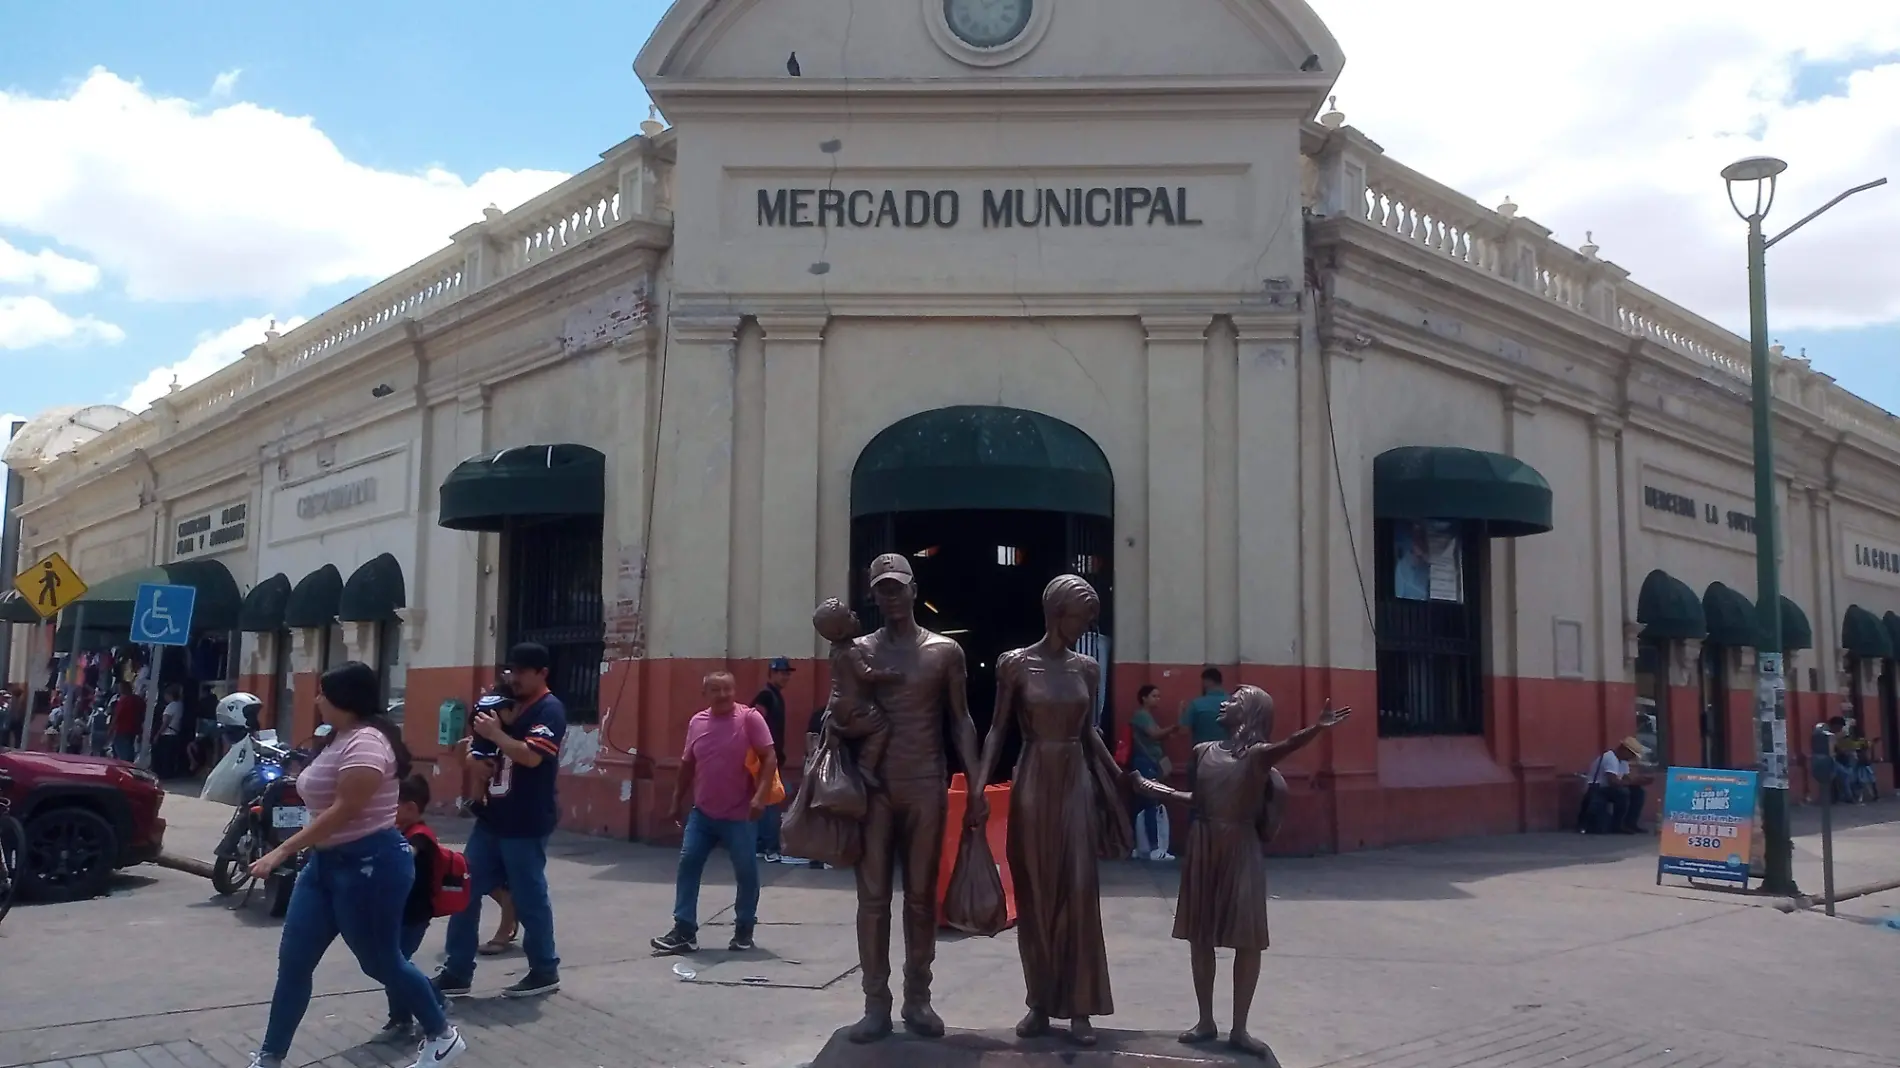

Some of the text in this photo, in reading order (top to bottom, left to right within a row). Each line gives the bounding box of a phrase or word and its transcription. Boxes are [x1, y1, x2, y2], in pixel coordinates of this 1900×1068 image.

[757, 186, 1203, 228] MERCADO MUNICIPAL
[1705, 503, 1719, 525] LA
[1688, 836, 1721, 849] $380
